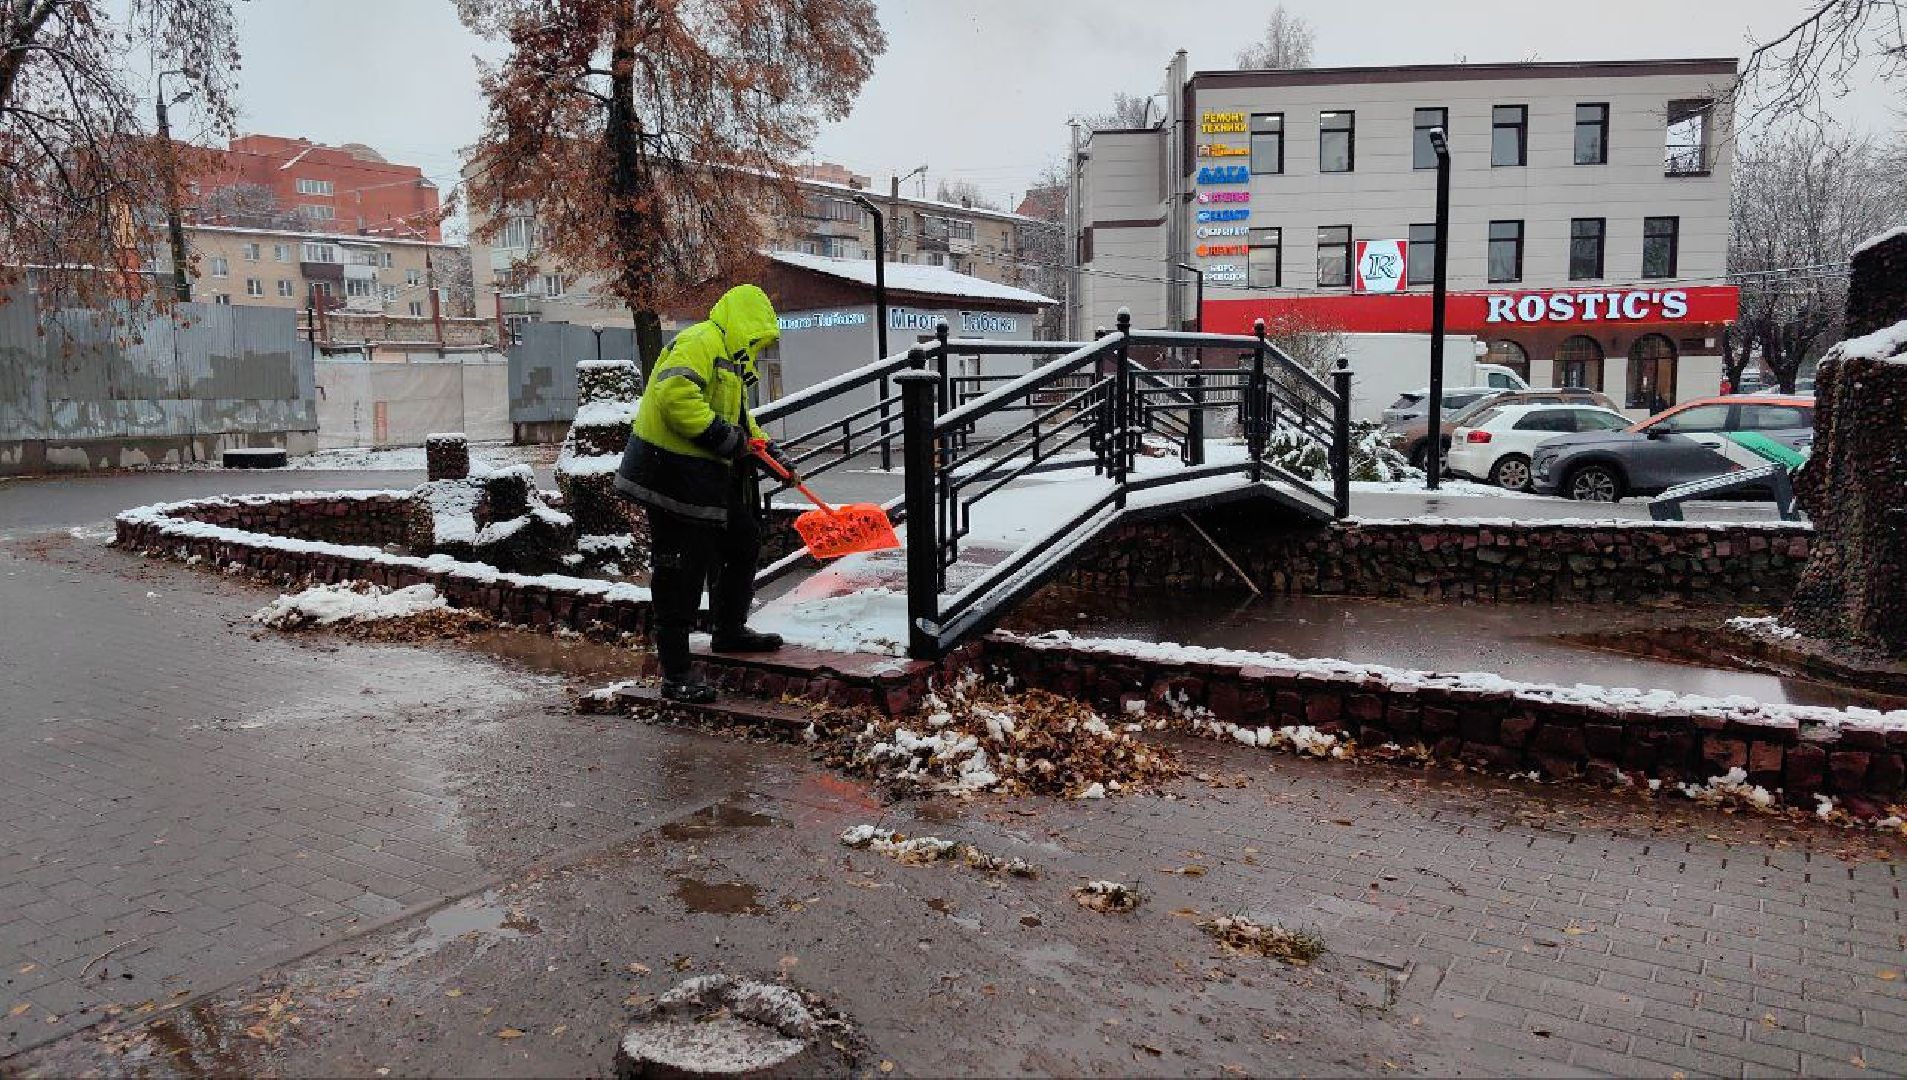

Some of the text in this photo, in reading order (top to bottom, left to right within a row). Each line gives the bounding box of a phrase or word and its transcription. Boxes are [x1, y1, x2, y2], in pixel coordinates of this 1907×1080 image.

[1203, 112, 1245, 124] РЕМОНТ
[1201, 123, 1248, 134] ТЕХНИКИ
[1364, 251, 1398, 281] R
[1486, 290, 1689, 323] ROSTIC'S
[776, 312, 866, 330] ного Табака
[959, 310, 1018, 333] Табака
